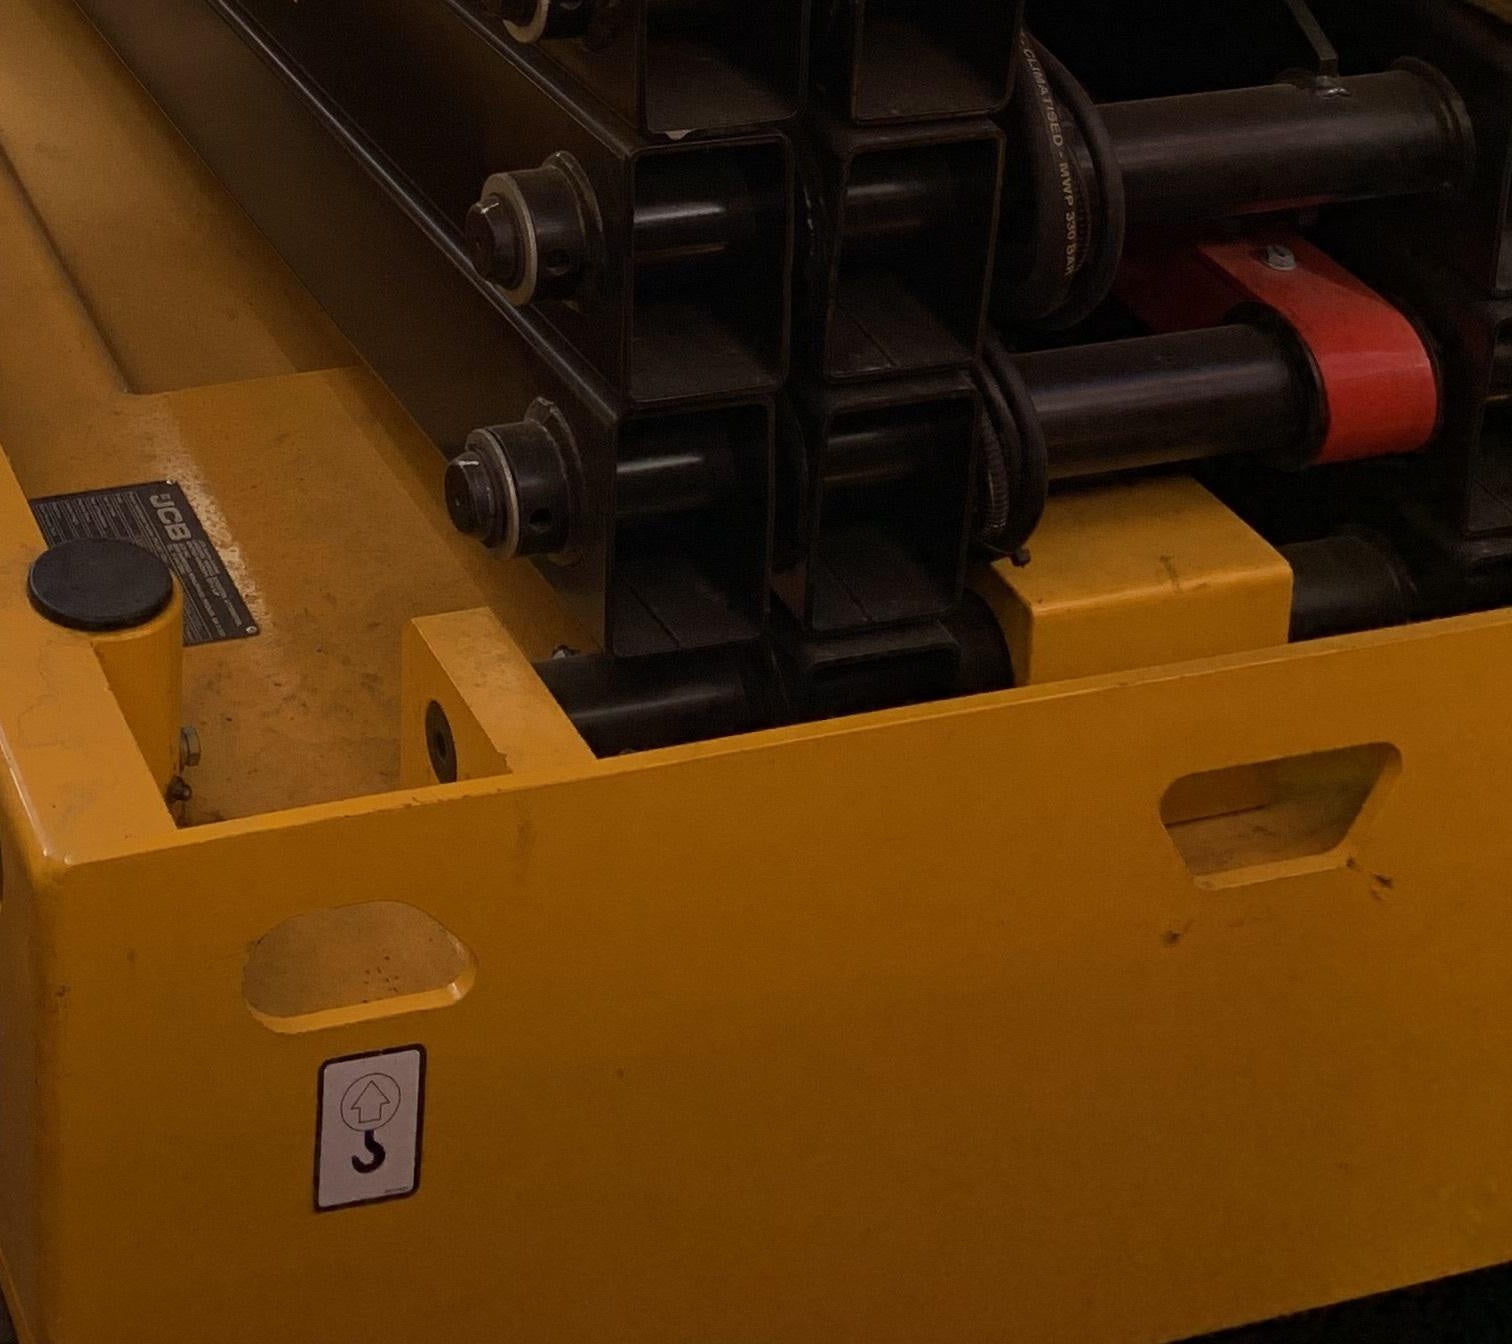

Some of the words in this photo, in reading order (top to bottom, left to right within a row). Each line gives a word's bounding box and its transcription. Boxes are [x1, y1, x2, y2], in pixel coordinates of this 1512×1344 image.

[1022, 47, 1065, 146] CLIMATISED
[1058, 162, 1075, 207] MWP
[149, 492, 192, 542] JCB
